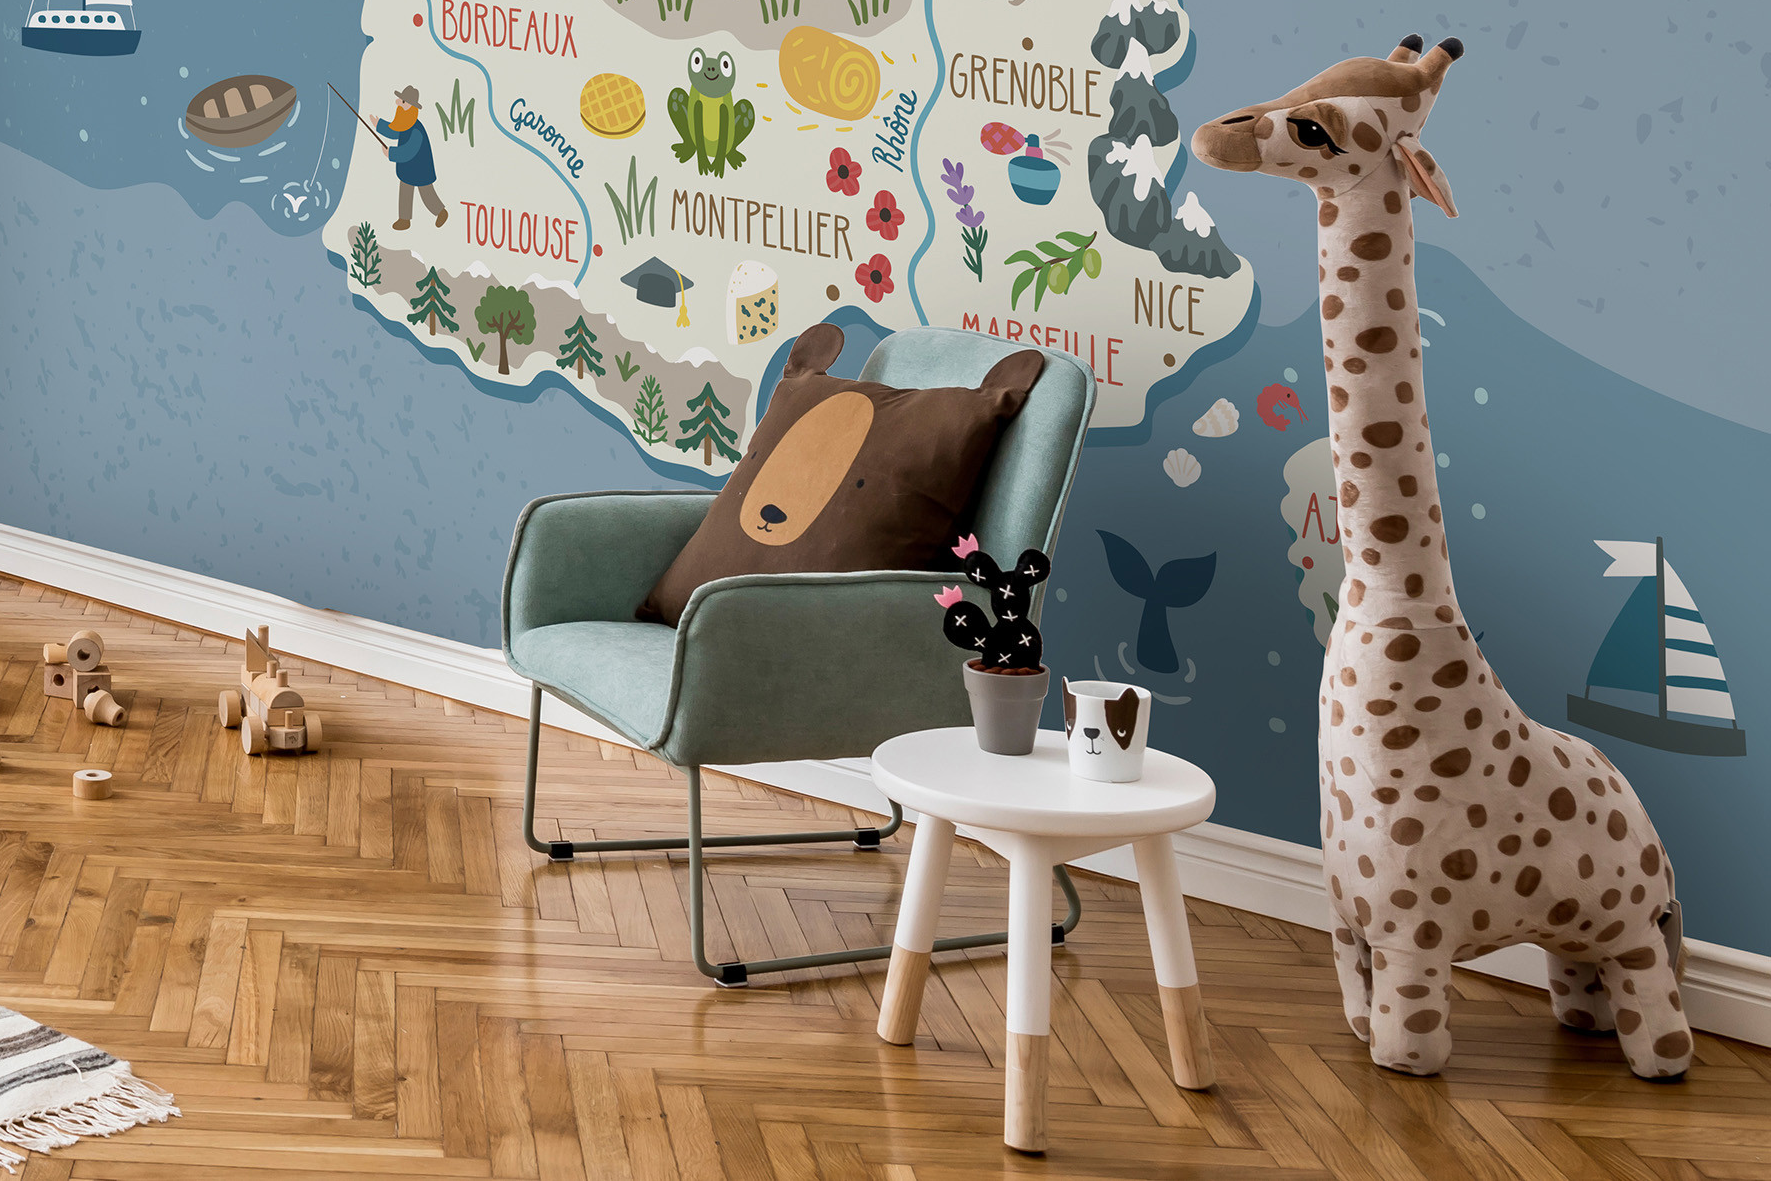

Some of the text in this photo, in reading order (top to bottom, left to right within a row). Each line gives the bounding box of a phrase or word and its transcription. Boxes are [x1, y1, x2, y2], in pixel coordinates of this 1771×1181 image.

[949, 52, 1103, 119] GRENOBLE
[509, 97, 585, 179] Garonne
[871, 89, 920, 174] Rhône
[459, 200, 580, 264] TOULOUSE
[670, 189, 854, 262] MONTPELLIER
[1134, 277, 1205, 337] NICE
